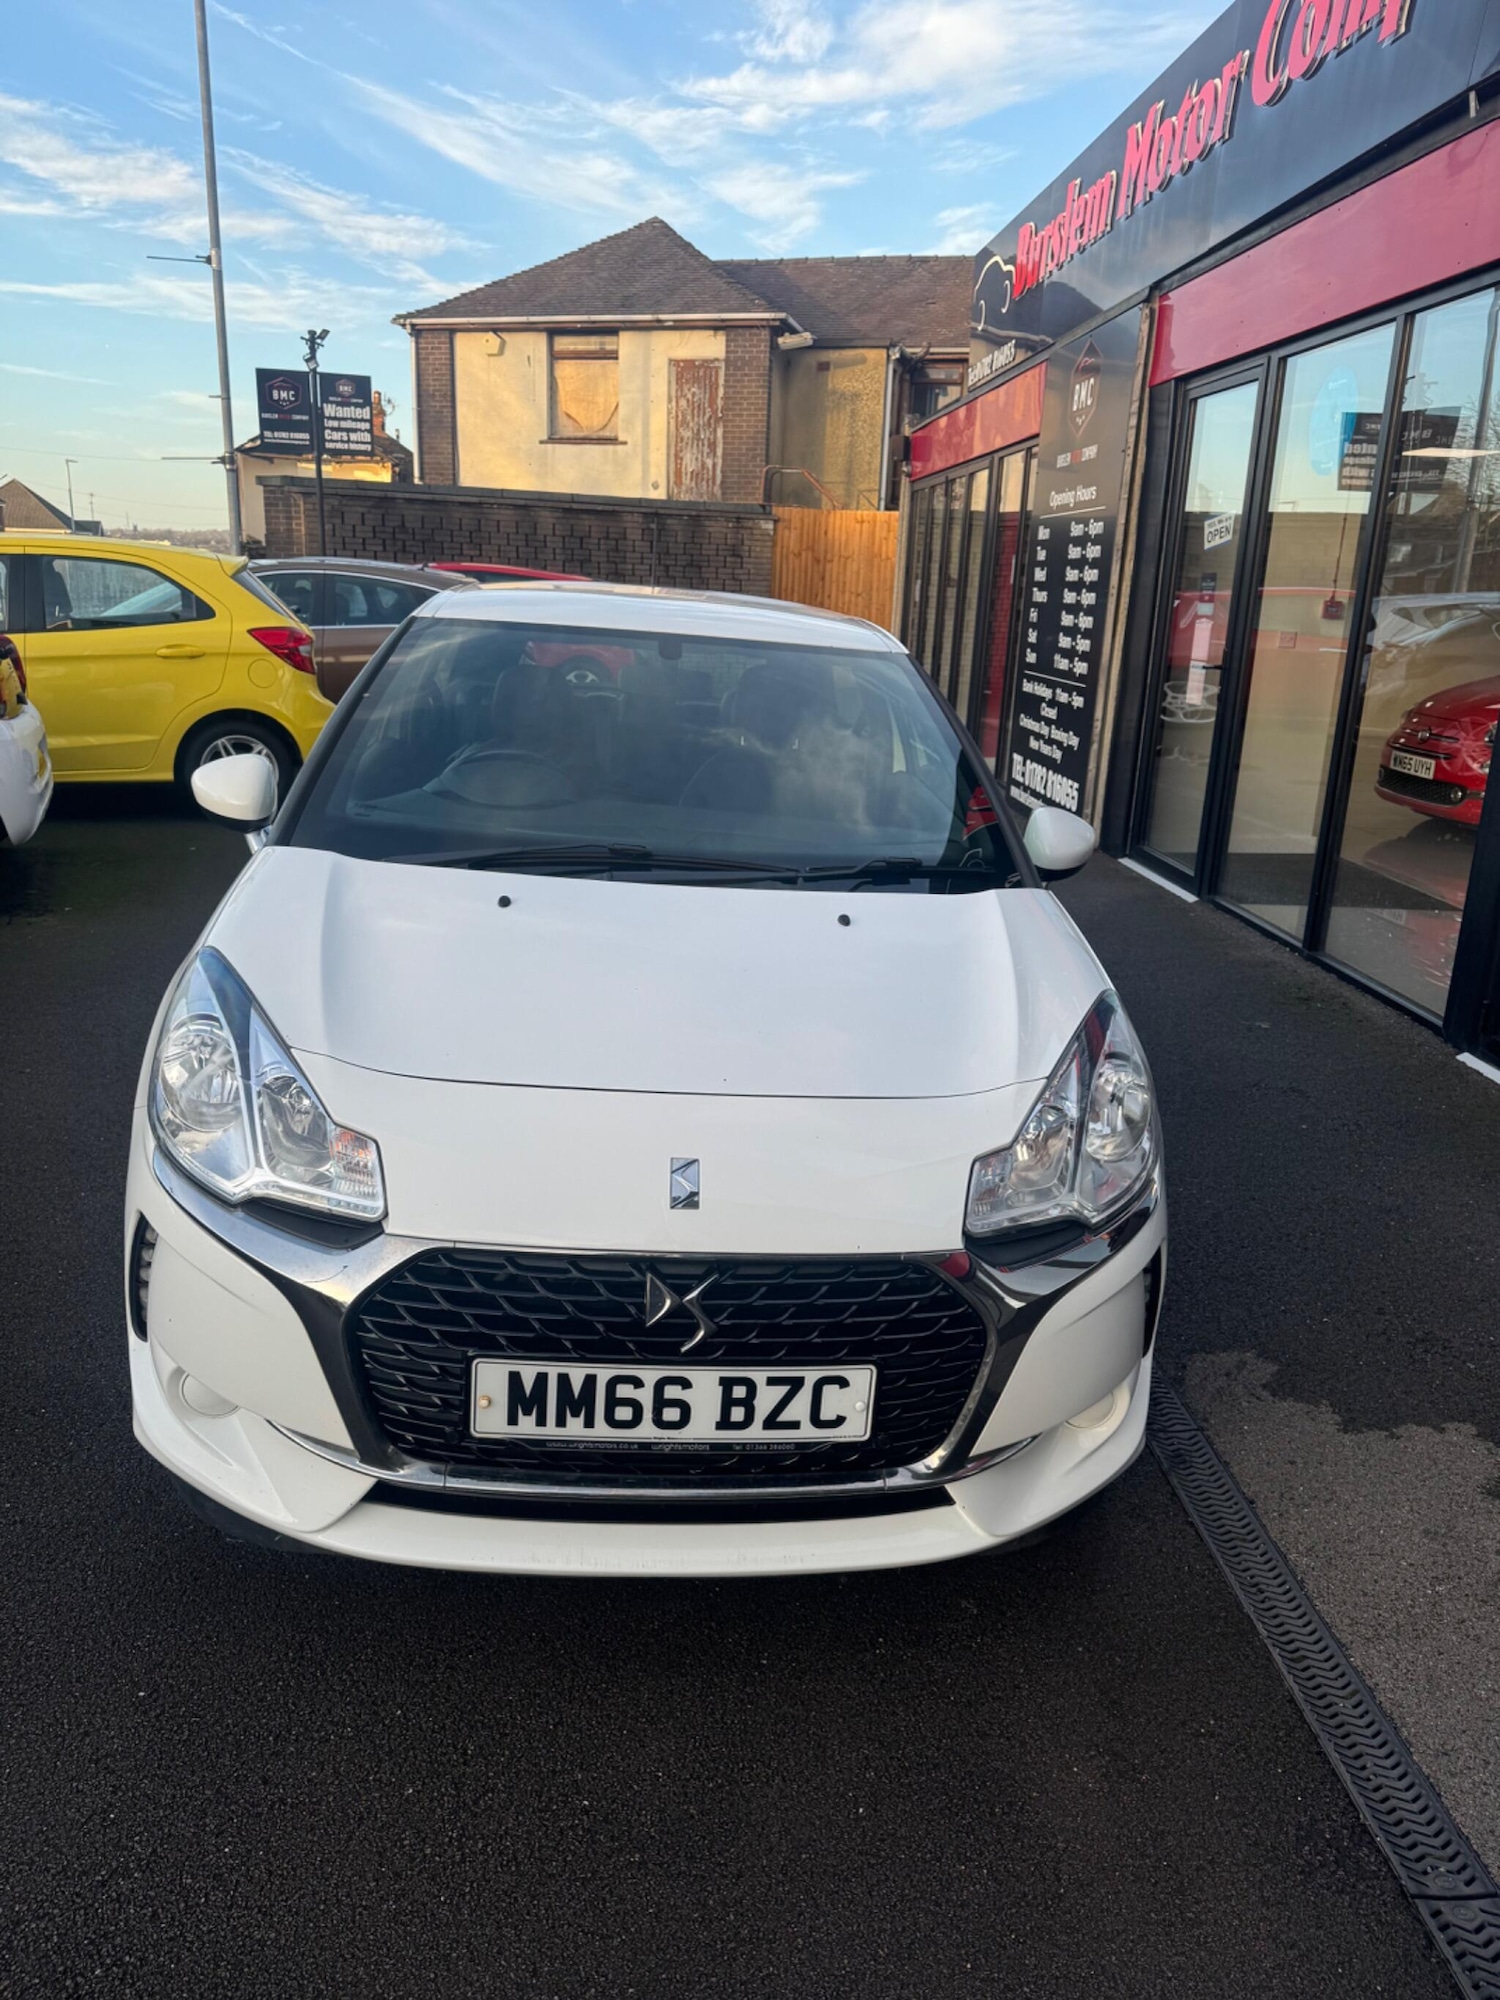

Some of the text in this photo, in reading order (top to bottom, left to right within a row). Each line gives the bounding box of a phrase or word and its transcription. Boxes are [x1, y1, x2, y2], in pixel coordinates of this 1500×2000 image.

[1012, 169, 1117, 299] Burslem
[1117, 49, 1250, 221] Motor
[272, 389, 296, 401] BMC
[1072, 377, 1094, 411] BMC
[323, 402, 370, 419] Wanted
[324, 418, 370, 430] Low mileage
[324, 429, 371, 443] Cars with
[1050, 485, 1098, 511] Opening Hours
[1038, 525, 1050, 540] Mon
[1207, 524, 1231, 543] OPEN
[1037, 546, 1046, 561] Tue
[1034, 567, 1047, 582] Wed
[1032, 587, 1048, 603] Thurs
[1029, 607, 1038, 623] Fri
[1027, 628, 1038, 644] Sat
[1026, 648, 1037, 664] Sun
[1040, 702, 1058, 720] Closed
[1067, 731, 1080, 751] Day
[1024, 758, 1047, 795] 01782
[507, 1371, 850, 1431] MM66 BZC
